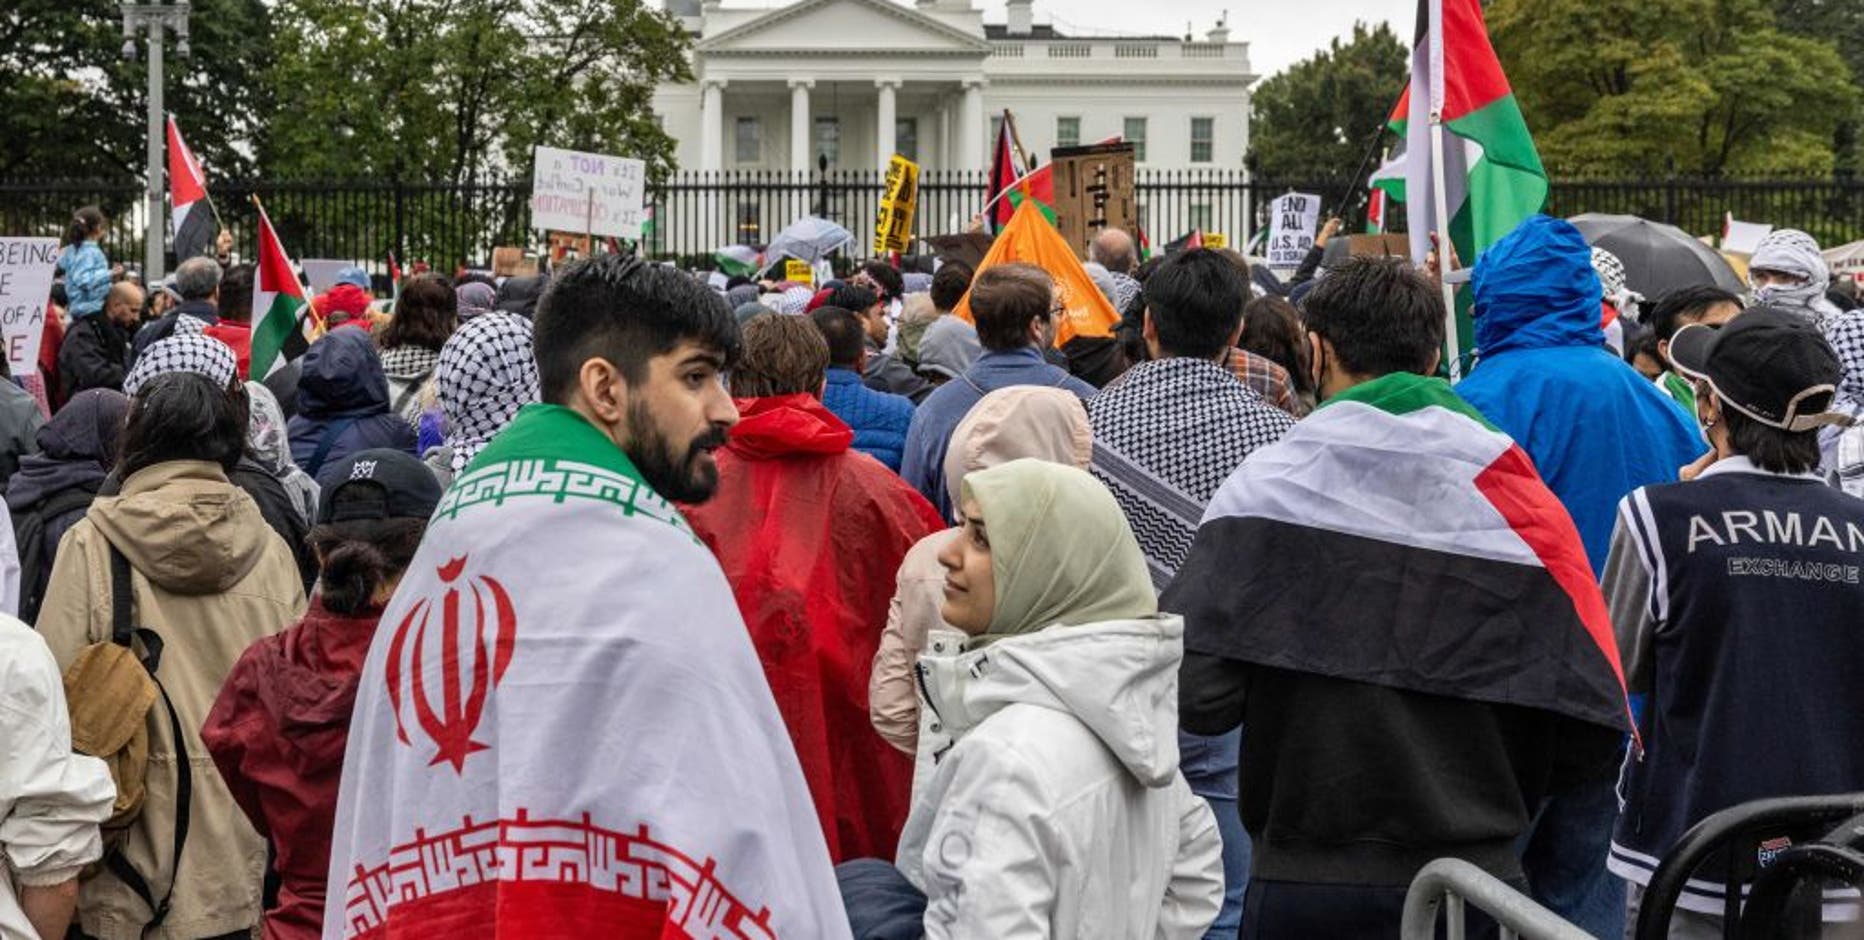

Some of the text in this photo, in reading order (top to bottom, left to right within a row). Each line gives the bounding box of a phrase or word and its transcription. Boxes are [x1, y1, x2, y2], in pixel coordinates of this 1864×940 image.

[1281, 196, 1307, 213] END
[1281, 213, 1303, 230] ALL
[1272, 235, 1295, 250] U.S.
[1283, 250, 1303, 261] ISRA
[3, 305, 43, 325] OF A
[1727, 556, 1860, 584] EXCHANGE
